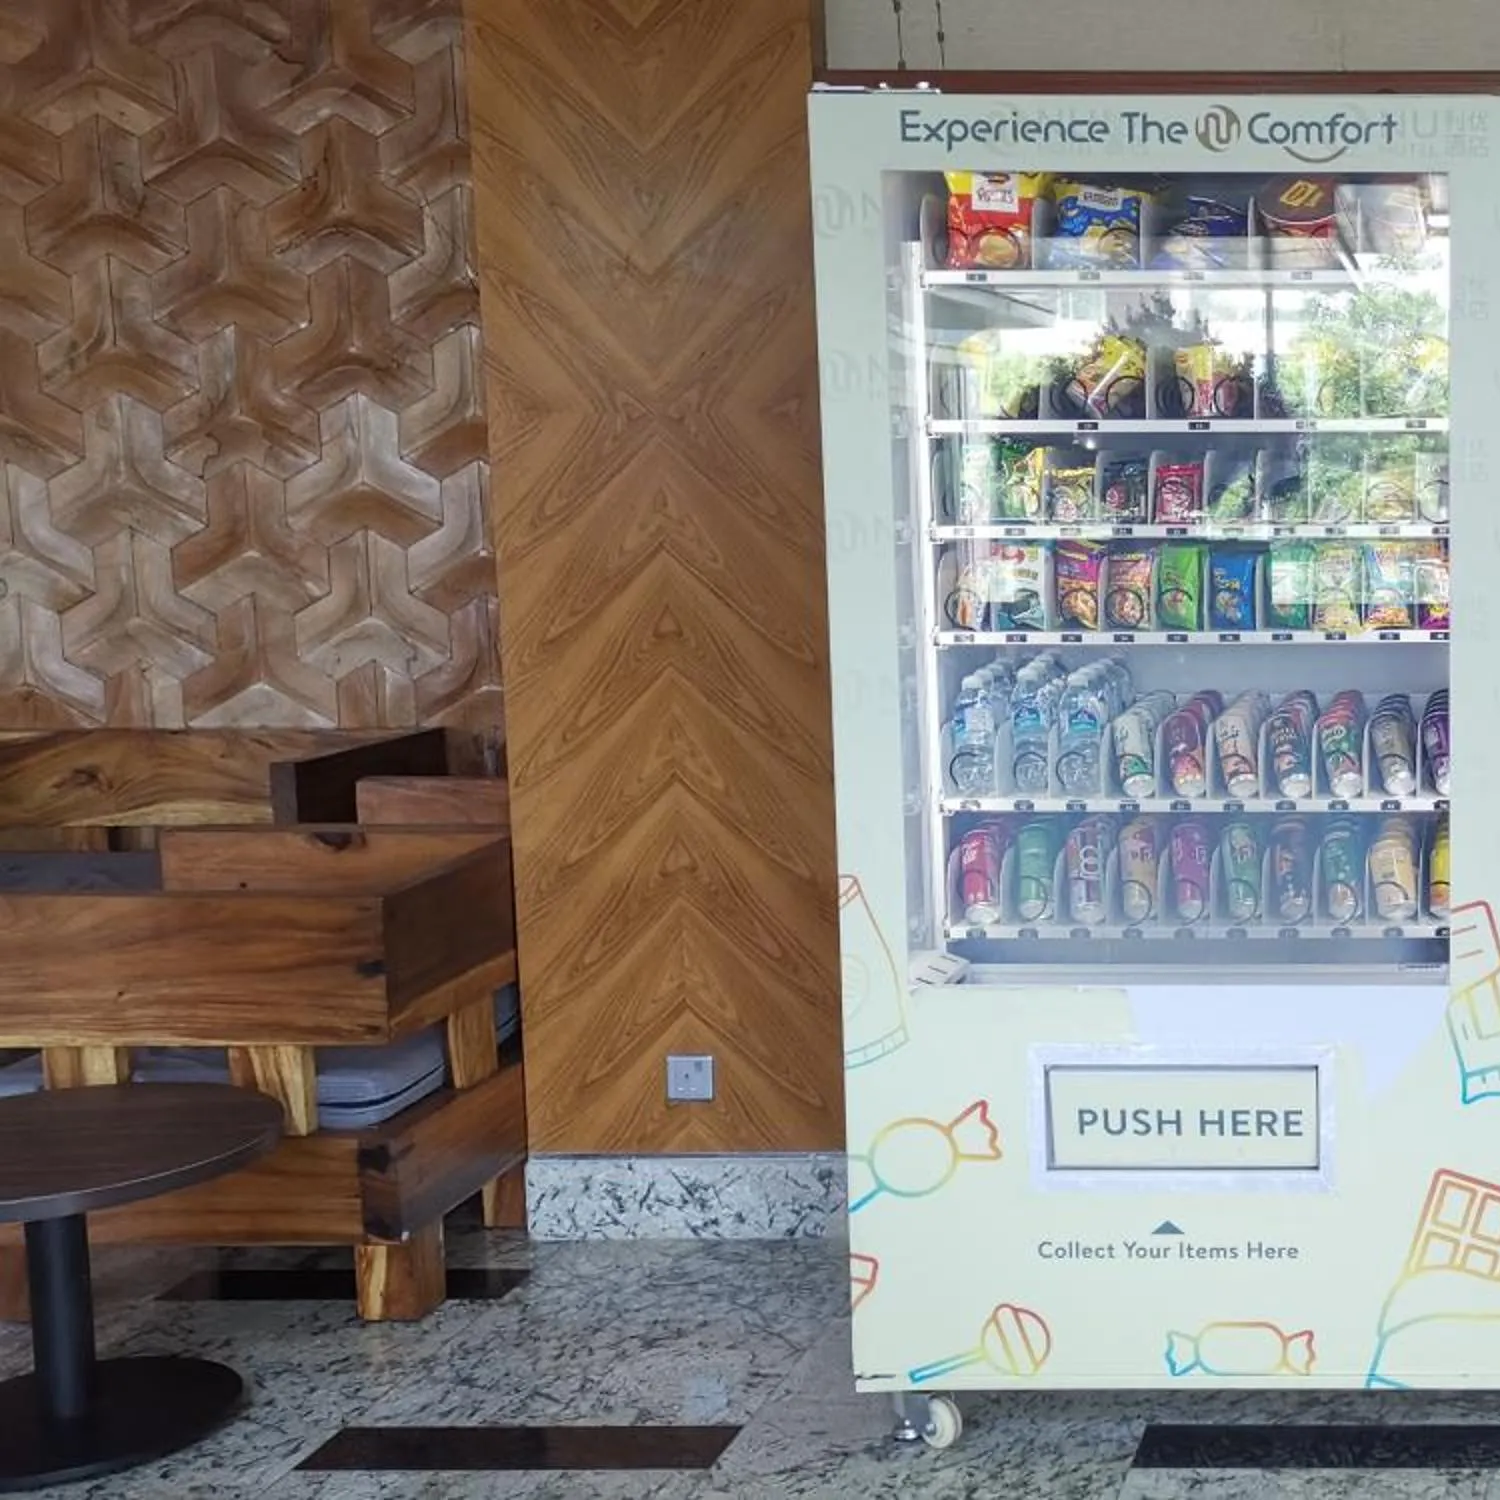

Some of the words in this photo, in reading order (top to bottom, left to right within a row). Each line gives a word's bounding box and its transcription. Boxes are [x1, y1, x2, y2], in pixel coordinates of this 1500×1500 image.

[898, 109, 1110, 153] Experience
[1120, 111, 1189, 145] The
[1247, 110, 1399, 145] Comfort
[1077, 1108, 1183, 1137] PUSH
[1199, 1108, 1304, 1137] HERE
[1037, 1241, 1116, 1260] Collect
[1124, 1241, 1171, 1260] Your
[1179, 1241, 1239, 1260] Items
[1247, 1241, 1300, 1260] Here
